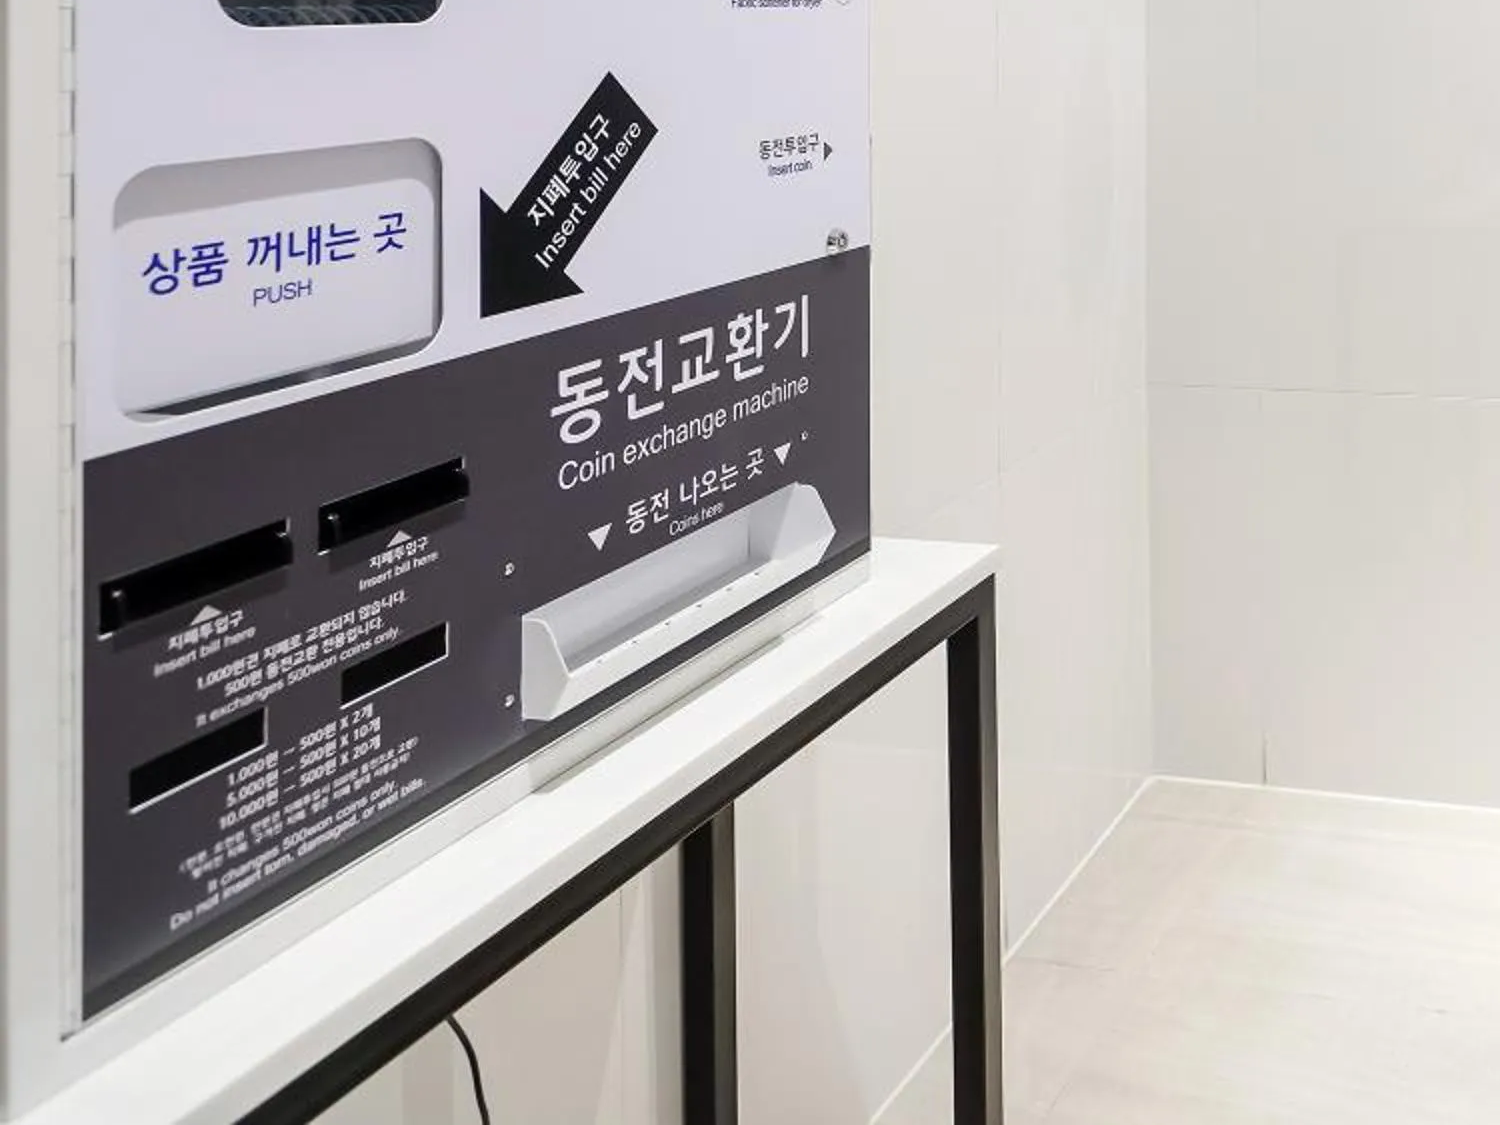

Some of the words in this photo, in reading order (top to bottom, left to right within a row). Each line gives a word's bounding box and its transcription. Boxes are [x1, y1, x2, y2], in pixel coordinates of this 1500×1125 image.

[528, 113, 612, 227] 지폐투입구
[759, 132, 821, 161] 동전투입구
[767, 162, 793, 177] Insert
[534, 203, 588, 270] Insert
[578, 166, 610, 205] bill
[604, 121, 642, 170] here
[142, 241, 229, 296] 상품
[246, 223, 360, 274] 꺼내는
[373, 212, 407, 254] 곳
[252, 278, 312, 307] PUSH
[550, 294, 809, 445] 동전교환기
[558, 450, 615, 491] Coin
[622, 406, 728, 466] exchange
[732, 374, 810, 423] machine
[625, 487, 670, 535] 동전
[679, 461, 739, 506] 나오는
[745, 448, 766, 481] 곳
[668, 515, 699, 537] Coins
[701, 501, 724, 521] here
[359, 568, 393, 593] Insert
[394, 561, 412, 579] bill
[413, 552, 438, 571] here
[154, 650, 198, 678] Insert
[199, 639, 222, 660] bill
[223, 626, 257, 650] here
[209, 680, 285, 722] exchanges
[287, 654, 338, 686] 500won
[339, 638, 372, 663] coins
[223, 668, 263, 698] 500원
[300, 720, 338, 751] 500원
[352, 703, 374, 724] 2개
[300, 738, 338, 769] 500원
[353, 716, 381, 740] 10개
[300, 756, 338, 788] 500원
[352, 734, 381, 761] 20개
[282, 815, 334, 852] 500won
[336, 796, 369, 823] coins
[377, 791, 399, 812] wet
